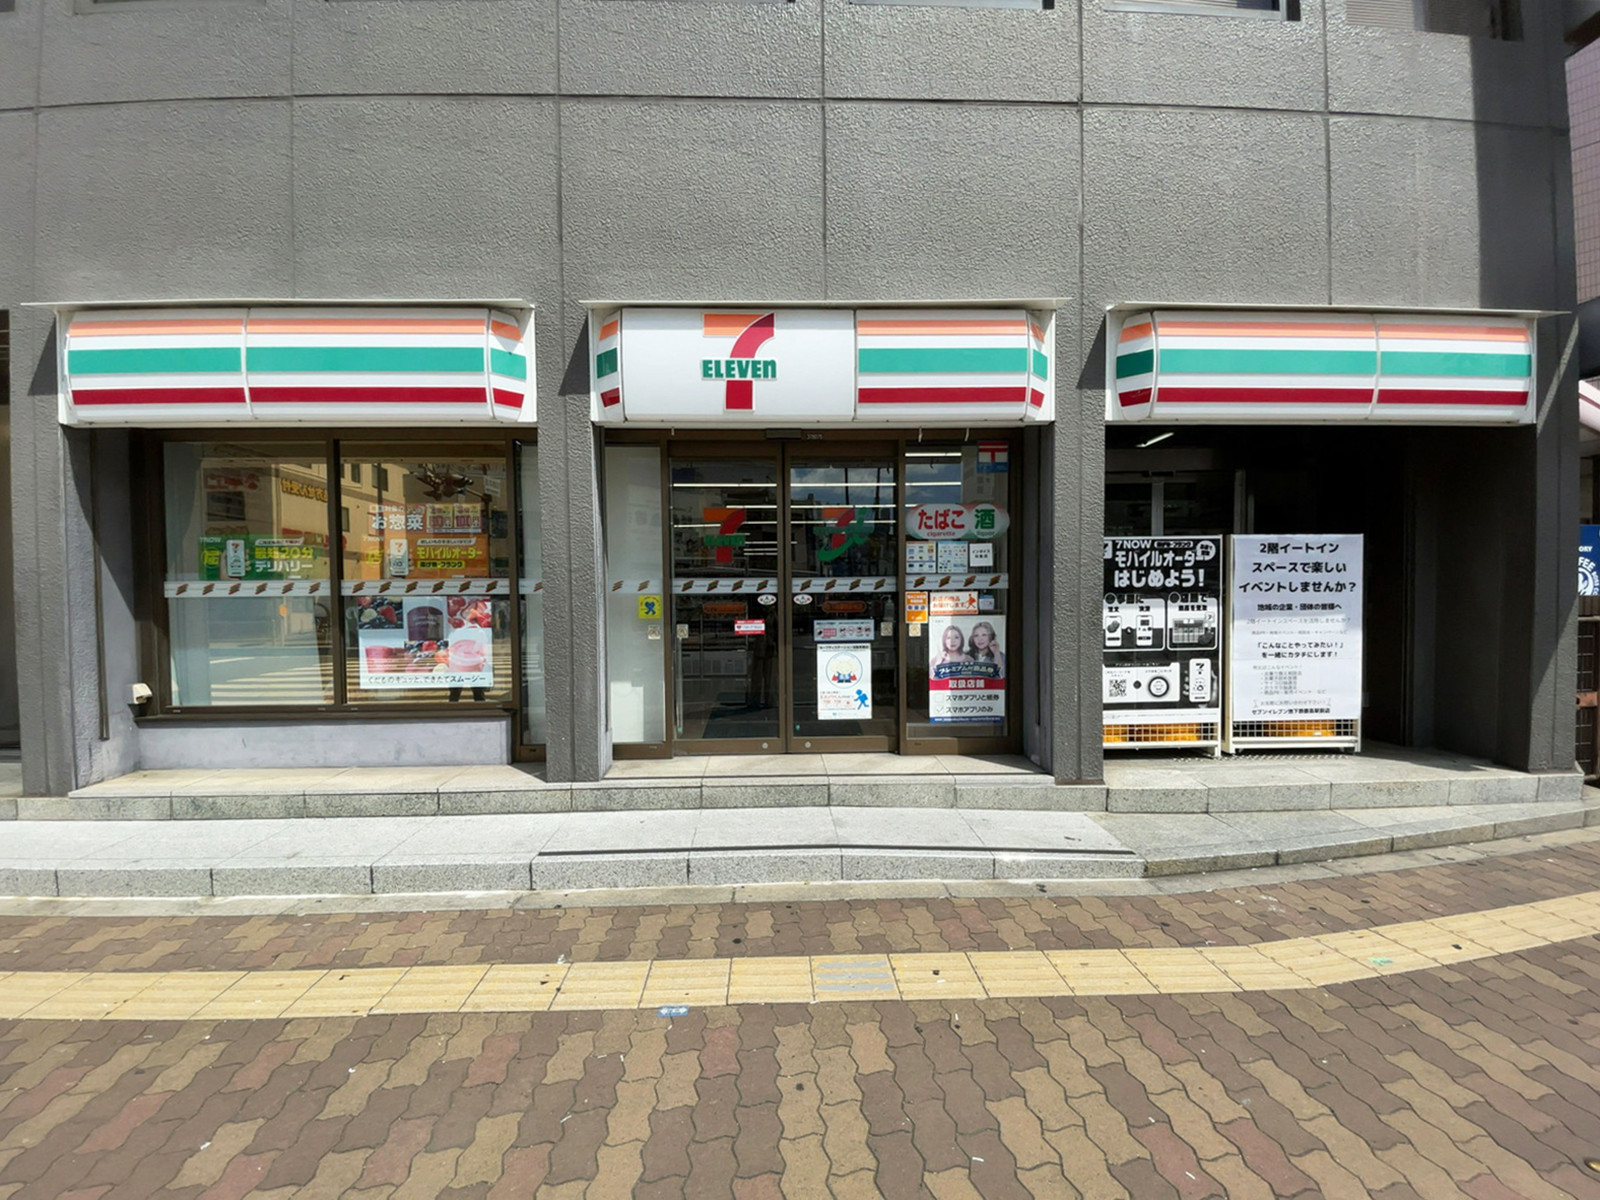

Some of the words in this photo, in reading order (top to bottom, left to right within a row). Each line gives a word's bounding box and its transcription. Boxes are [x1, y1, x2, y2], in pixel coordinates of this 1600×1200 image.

[702, 359, 777, 378] ELEVEn
[703, 312, 775, 410] 7
[371, 513, 424, 531] お惣菜
[918, 508, 965, 530] たばこ
[974, 508, 996, 530] 酒
[1115, 540, 1152, 549] 7NOW
[1259, 542, 1340, 554] 2階イートイン
[255, 560, 313, 572] デリバリー
[1252, 562, 1347, 574] スペースで楽しい
[1114, 568, 1205, 588] はじめよう！
[1239, 581, 1356, 593] イベントしませんか？
